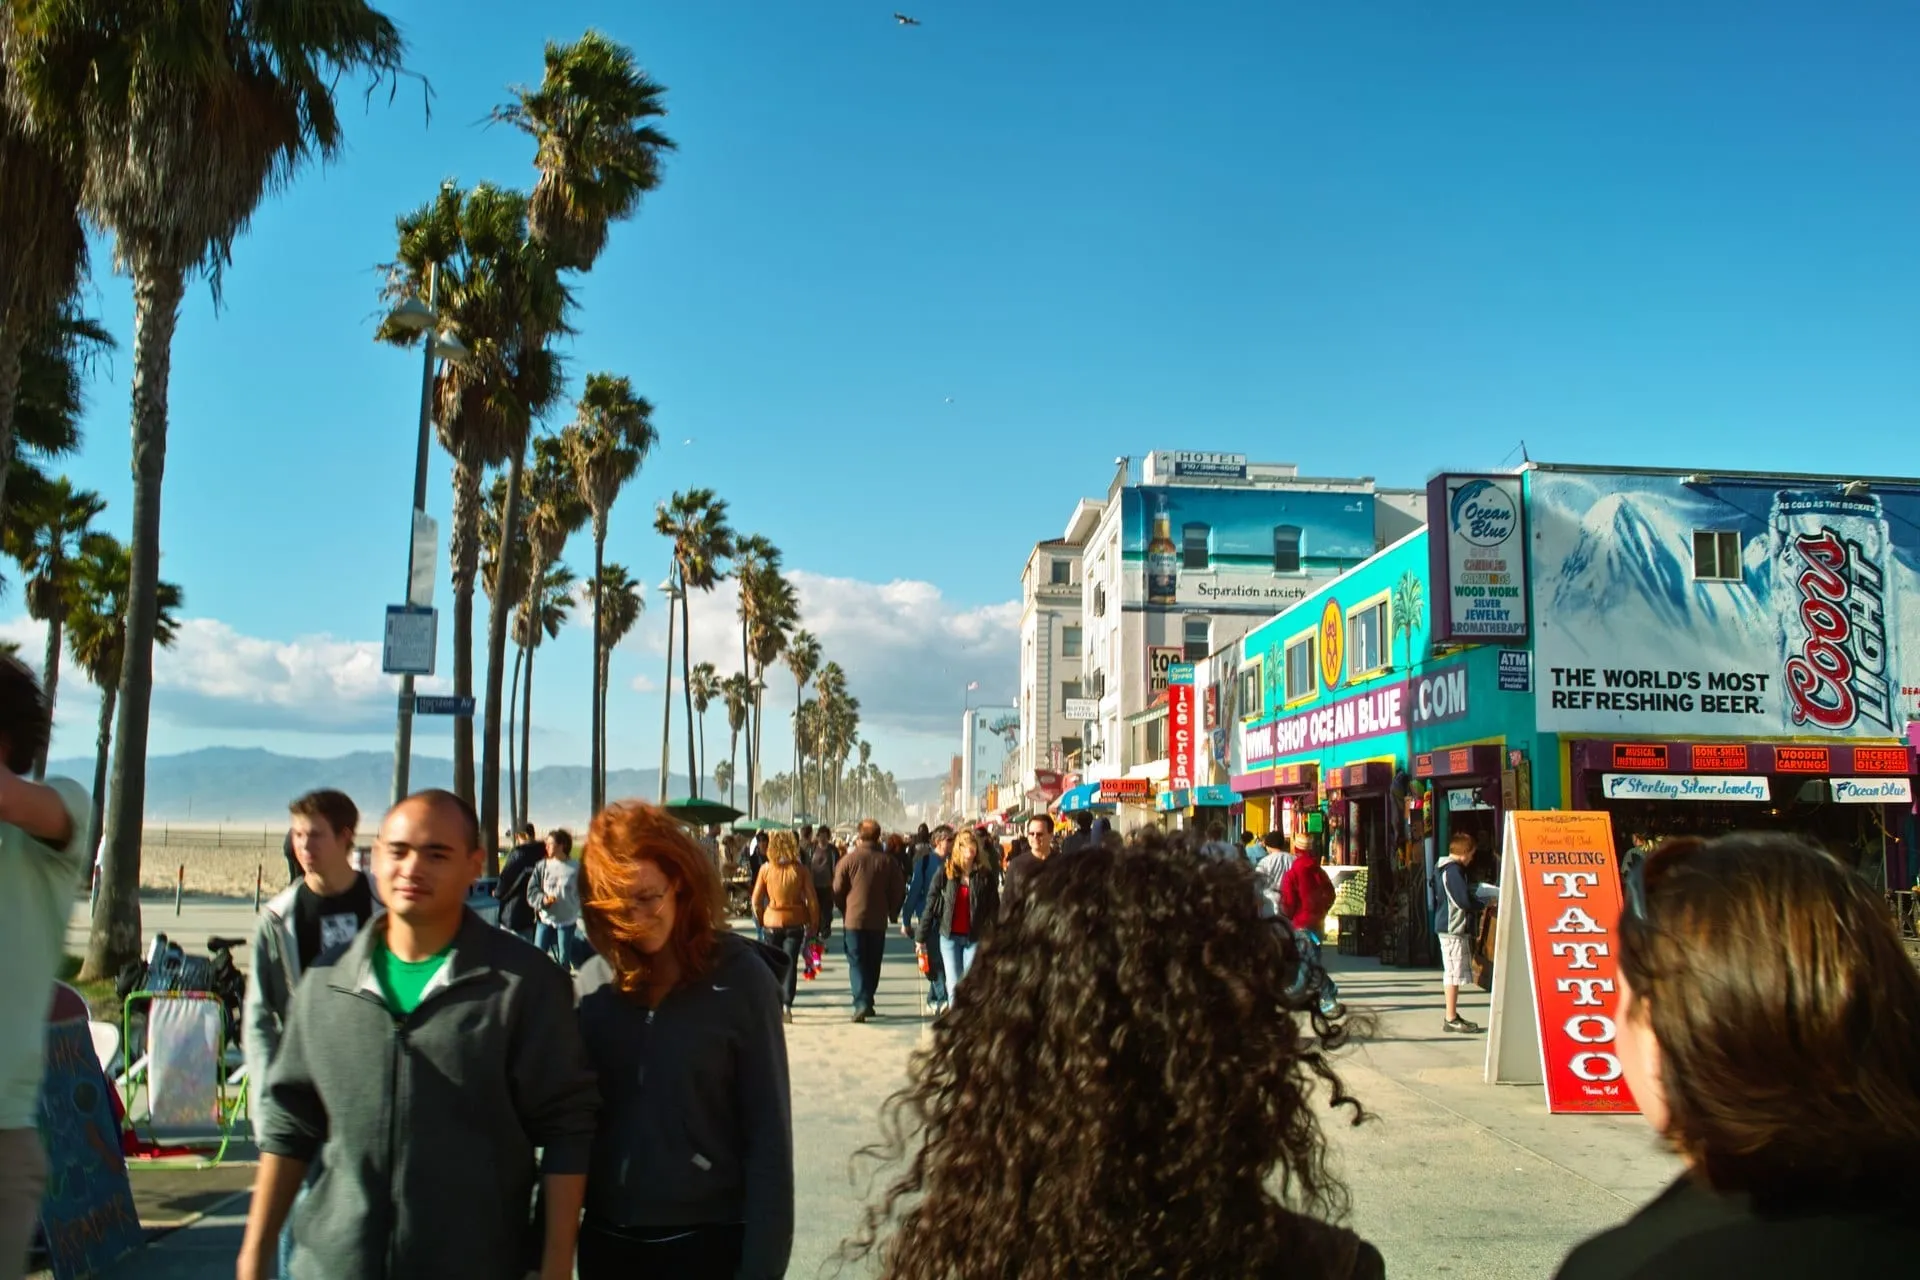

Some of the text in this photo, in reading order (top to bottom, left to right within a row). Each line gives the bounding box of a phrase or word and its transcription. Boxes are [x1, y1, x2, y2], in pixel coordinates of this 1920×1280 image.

[1181, 453, 1240, 464] HOTEL
[1465, 502, 1511, 521] Ocean
[1791, 501, 1812, 509] COLD
[1842, 502, 1875, 512] ROCKIES
[1470, 519, 1508, 538] Blue
[1461, 573, 1511, 585] CARVINGS
[1198, 583, 1260, 600] Separation
[1454, 586, 1519, 597] WOOD WORK
[1474, 599, 1501, 608] SILVER
[1465, 609, 1510, 621] JEWELRY
[1451, 622, 1526, 634] AROMATHERAPY
[1785, 526, 1856, 730] Coors
[1849, 538, 1894, 732] LIGHT
[1500, 653, 1527, 666] ATM
[1151, 674, 1169, 690] rin
[1551, 668, 1770, 692] THE WORLD'S MOST
[1176, 686, 1188, 725] ice
[1552, 691, 1694, 712] REFRESHING
[1277, 716, 1308, 753] SHOP
[1310, 701, 1355, 745] OCEAN
[1358, 688, 1401, 734] BLUE
[1413, 669, 1466, 722] .COM
[1625, 748, 1656, 757] MUSICAL
[1781, 750, 1825, 760] WOODEN
[1857, 751, 1904, 760] INCENSE
[1174, 730, 1191, 789] cream
[1617, 757, 1665, 767] INSTRUMENTS
[1778, 760, 1827, 769] CARVINGS
[1102, 780, 1146, 791] toe rings
[1626, 778, 1764, 799] Sterling Silver Jewelry
[1848, 782, 1906, 796] Ocean Blue
[1528, 852, 1606, 865] PIERCING
[1542, 871, 1624, 1082] TATTOO
